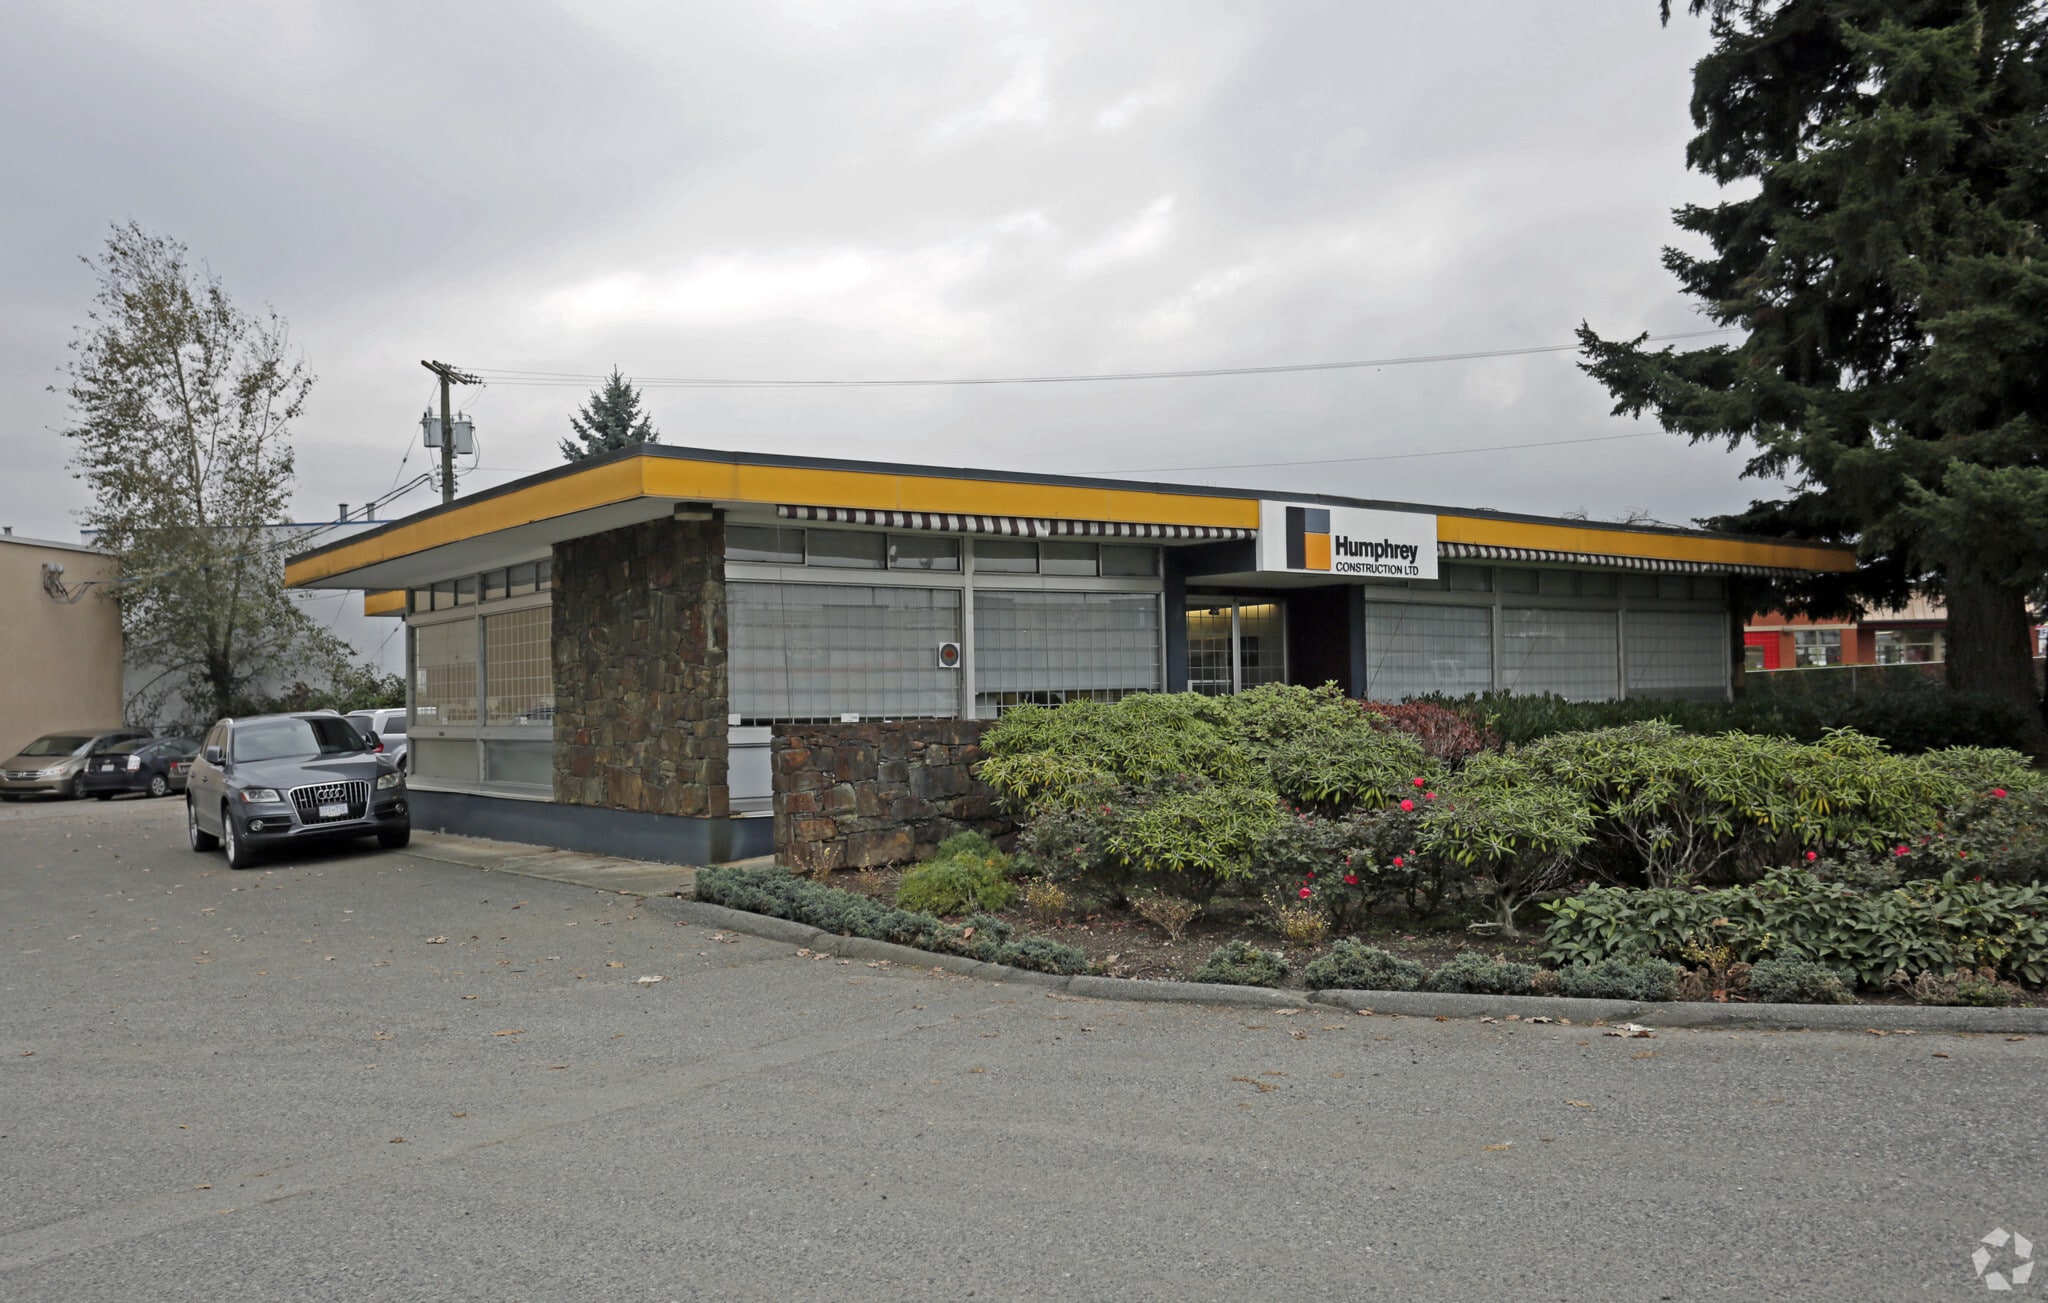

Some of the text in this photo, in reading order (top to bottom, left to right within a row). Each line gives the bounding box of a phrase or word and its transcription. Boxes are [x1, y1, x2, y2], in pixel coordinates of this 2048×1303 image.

[1335, 535, 1418, 564] Humphrey
[1335, 561, 1419, 576] CONSTRUCTION LTD
